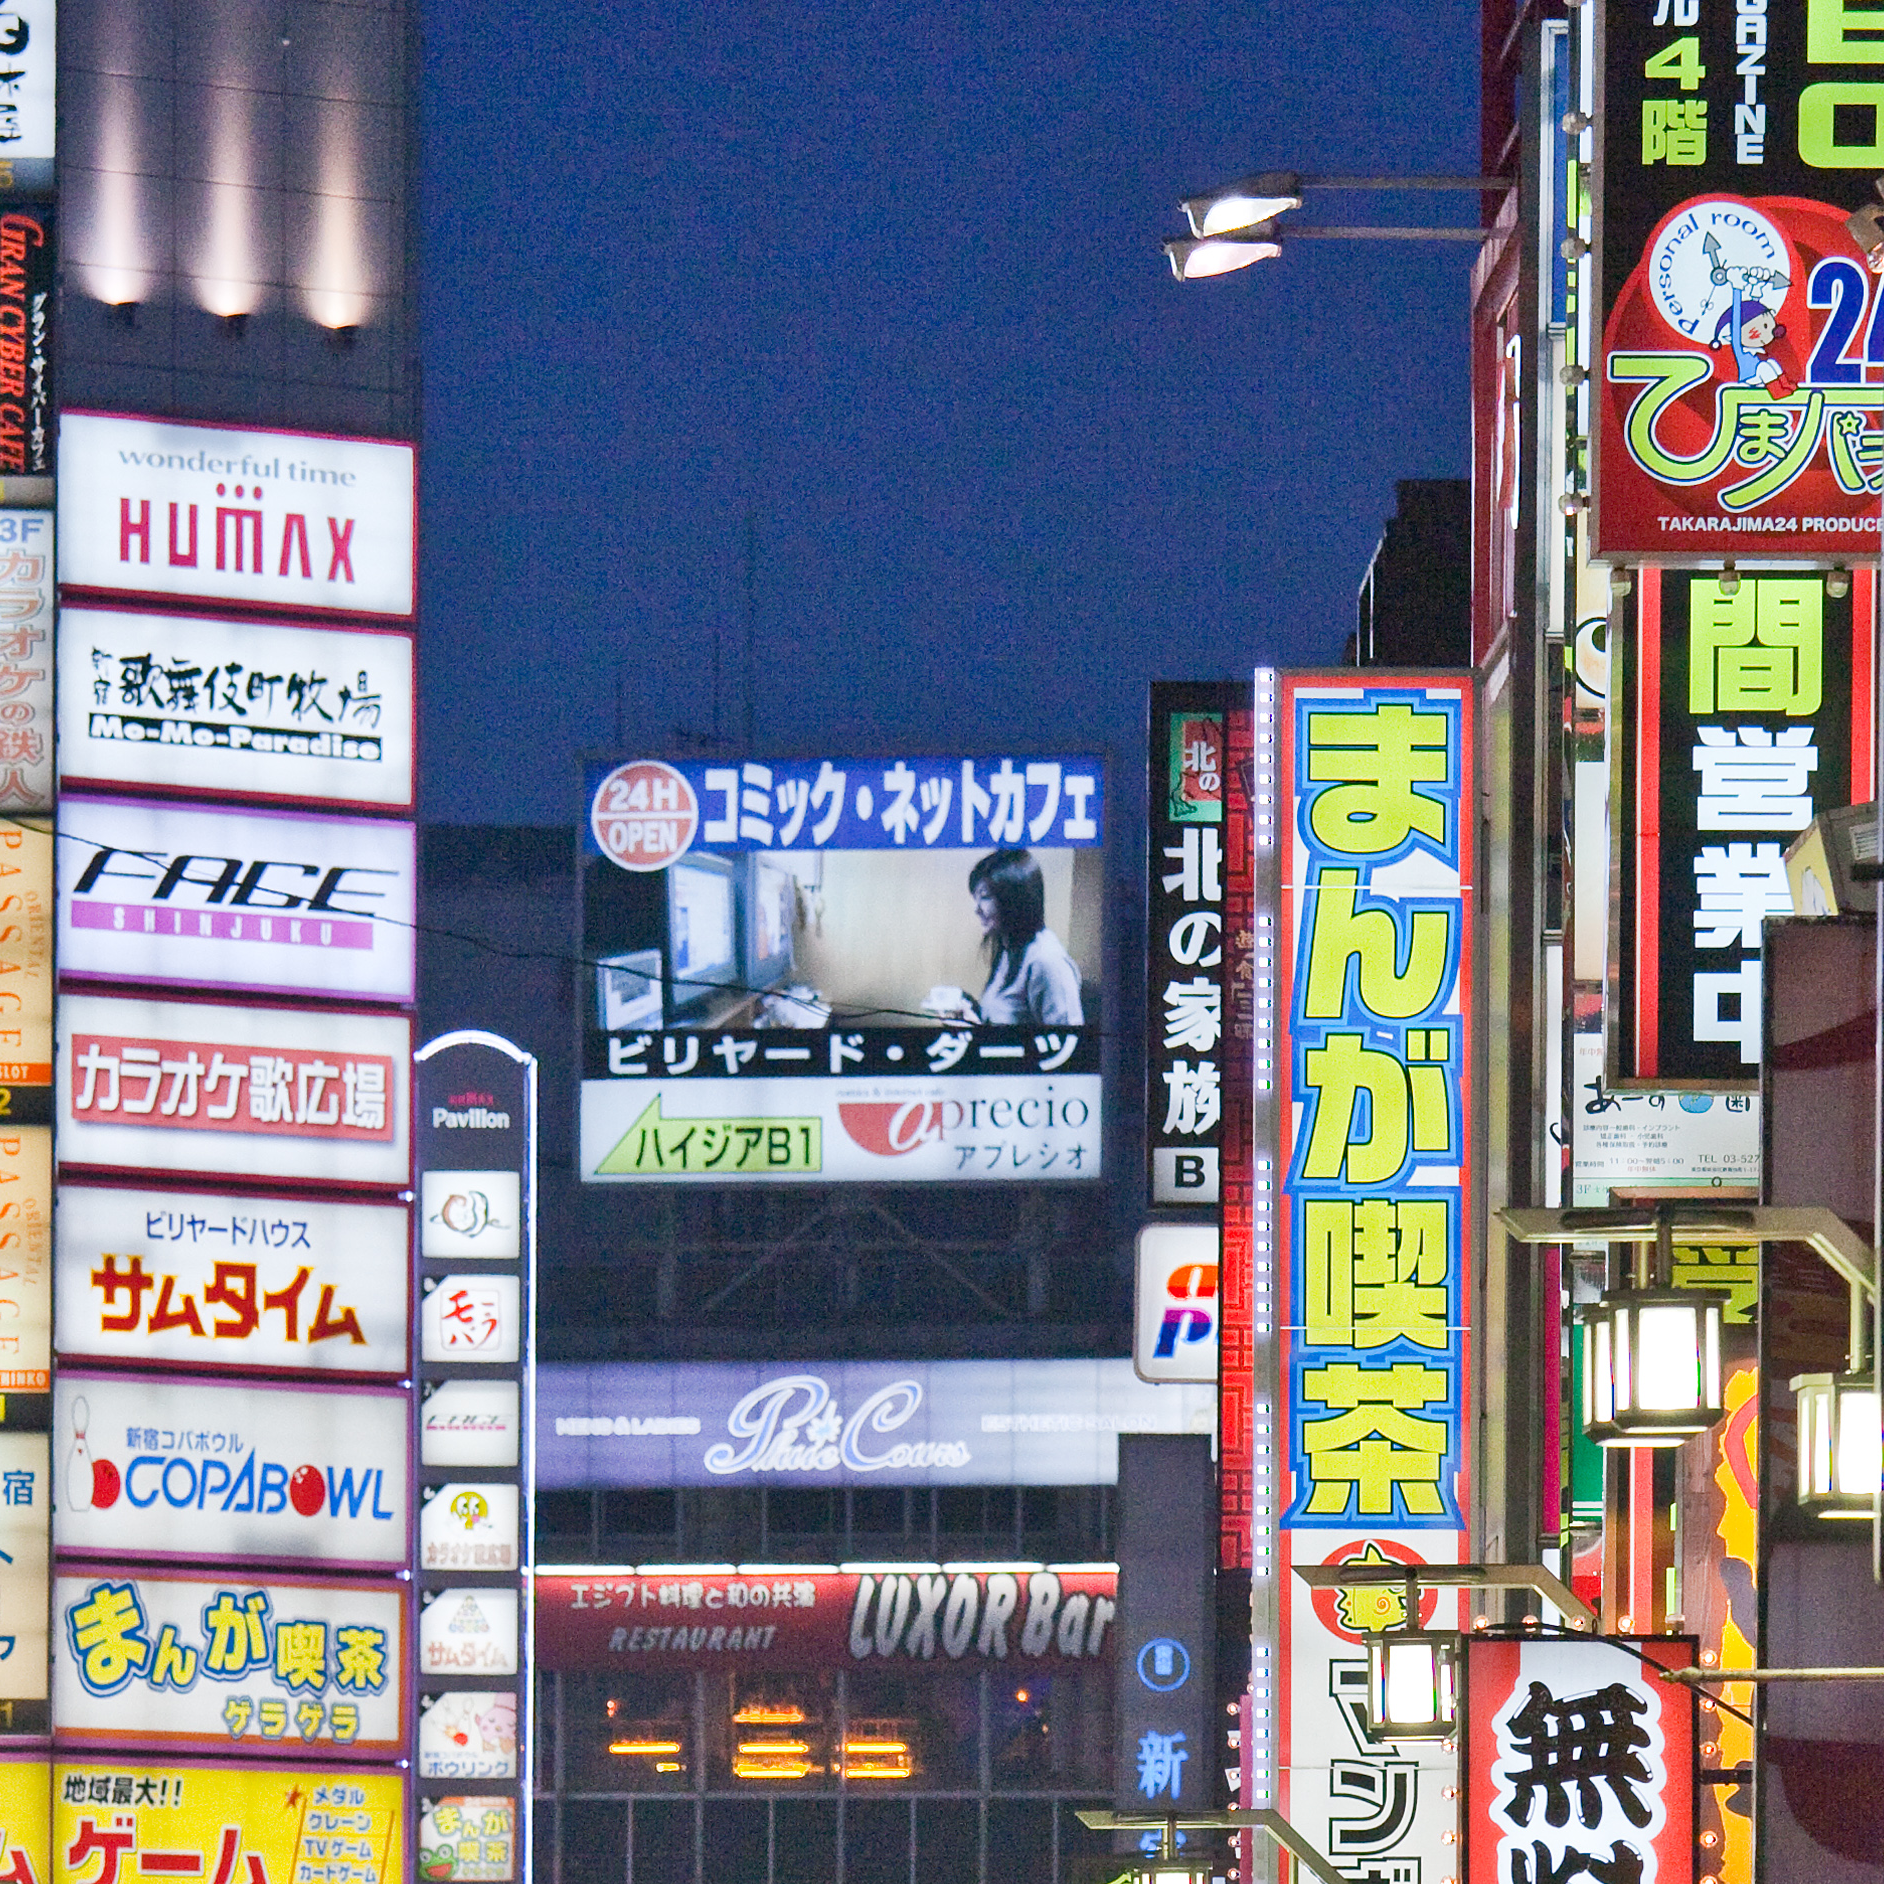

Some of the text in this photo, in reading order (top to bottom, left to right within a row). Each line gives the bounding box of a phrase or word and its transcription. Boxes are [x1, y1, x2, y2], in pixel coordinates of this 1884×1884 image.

[1662, 212, 1777, 339] Personal room
[118, 447, 358, 488] wonderful time
[118, 482, 357, 585] HUMAX
[1657, 515, 1799, 534] TAKARAJIMA24
[118, 651, 383, 730] 歌舞伎町牧場
[88, 712, 383, 764] Mo-Mo-Paradise
[606, 780, 680, 813] 24H
[703, 759, 1098, 848] コミック・ネットカフェ
[607, 823, 679, 855] OPEN
[73, 847, 401, 919] FACE
[111, 905, 335, 944] SHINJUKU
[1162, 827, 1222, 1138] 北の家族
[607, 1032, 1079, 1076] ビリヤード・ダーツ
[76, 1040, 389, 1135] カラオケ歌広場
[432, 1106, 512, 1131] Pavilion
[1303, 703, 1449, 1515] まんが喫茶
[635, 1125, 813, 1170] ハイジアB1
[954, 1143, 1087, 1169] アプレシオ
[145, 1210, 314, 1251] ビリヤードハウス
[89, 1251, 369, 1346] サムタイム
[125, 1426, 245, 1456] 新宿コパボウル
[125, 1446, 396, 1521] COPABOWL
[849, 1571, 1117, 1660] LUXOR Bar
[66, 1578, 393, 1699] まんが喫茶
[609, 1625, 777, 1652] RESTAURANT
[223, 1694, 366, 1744] ゲラゲラ
[427, 1760, 509, 1777] ボウリング
[64, 1775, 184, 1808] 地域最大!!
[312, 1785, 366, 1807] メダル
[308, 1811, 372, 1833] クレーン
[433, 1805, 510, 1839] まんが
[303, 1837, 373, 1860] TVゲーム
[299, 1864, 378, 1884] カードゲーム
